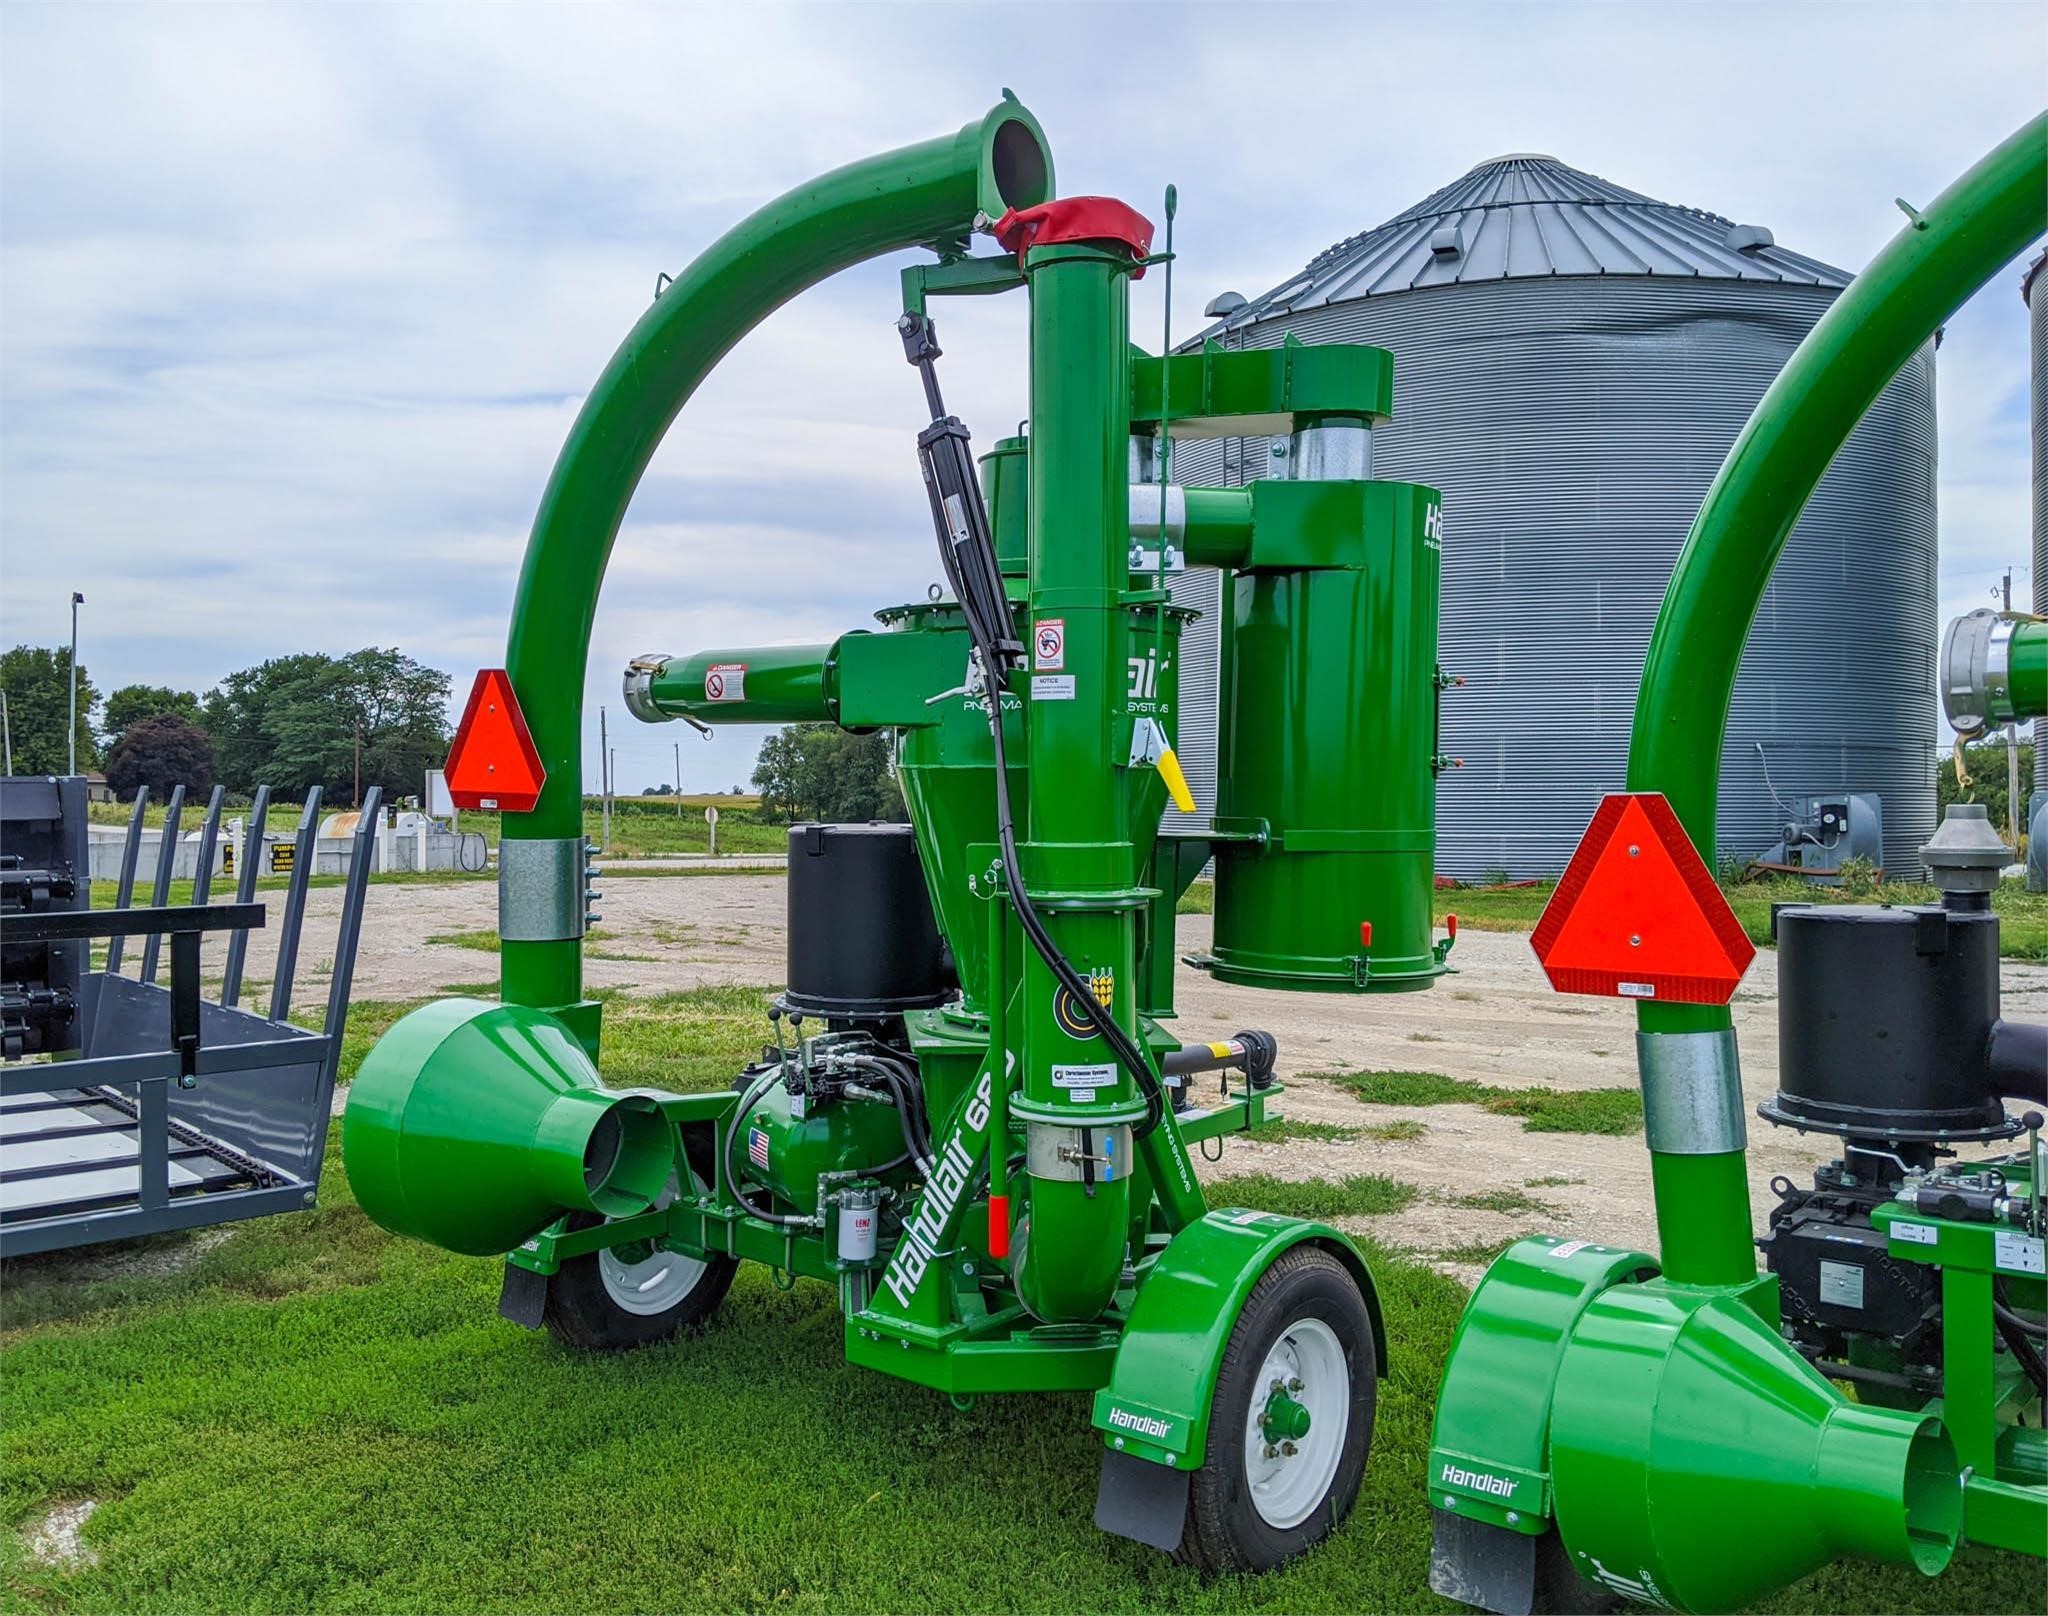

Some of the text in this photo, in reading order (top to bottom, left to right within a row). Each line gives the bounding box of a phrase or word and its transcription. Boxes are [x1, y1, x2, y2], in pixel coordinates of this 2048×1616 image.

[884, 1127, 974, 1309] Handlair
[1109, 1407, 1171, 1438] Handlair
[1442, 1464, 1517, 1498] Handlair
